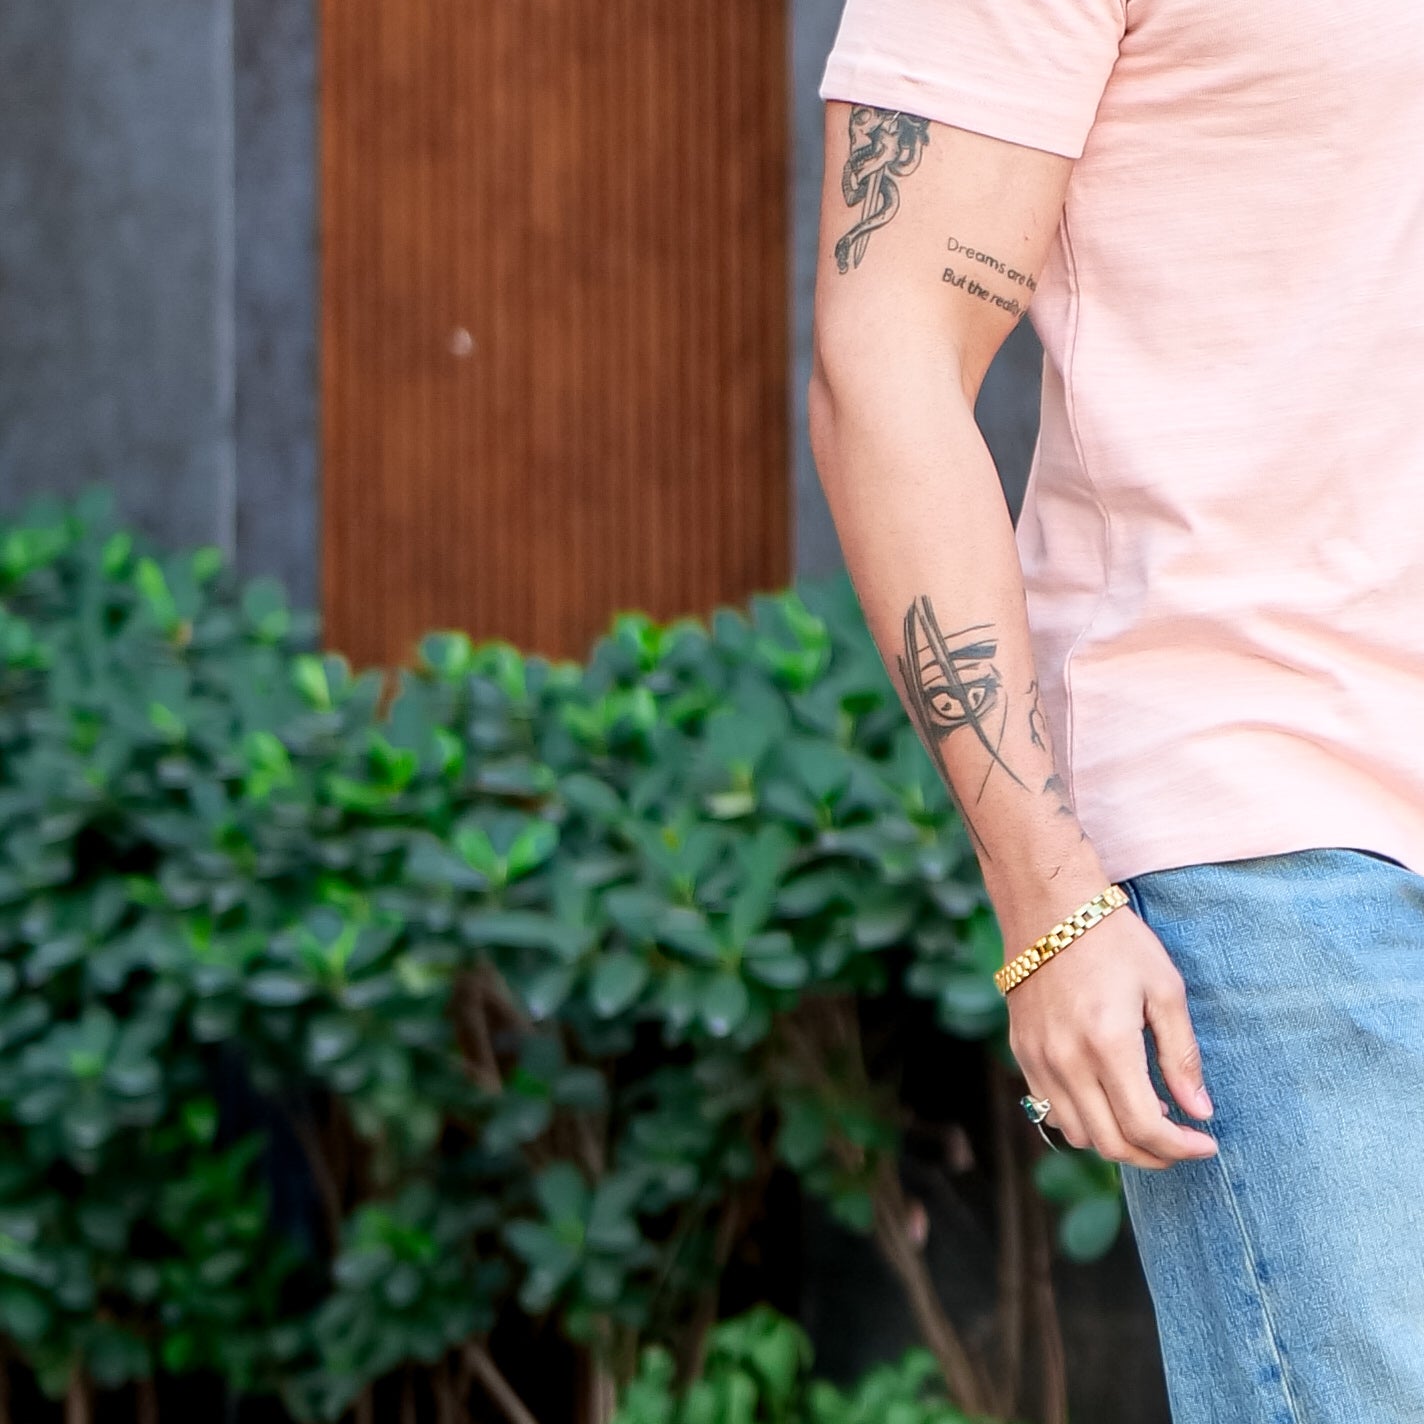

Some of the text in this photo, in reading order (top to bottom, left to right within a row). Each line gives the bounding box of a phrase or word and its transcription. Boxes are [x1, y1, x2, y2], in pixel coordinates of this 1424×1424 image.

[947, 236, 1006, 274] Dreams
[1007, 269, 1026, 285] are
[942, 267, 967, 289] But
[967, 280, 990, 301] the
